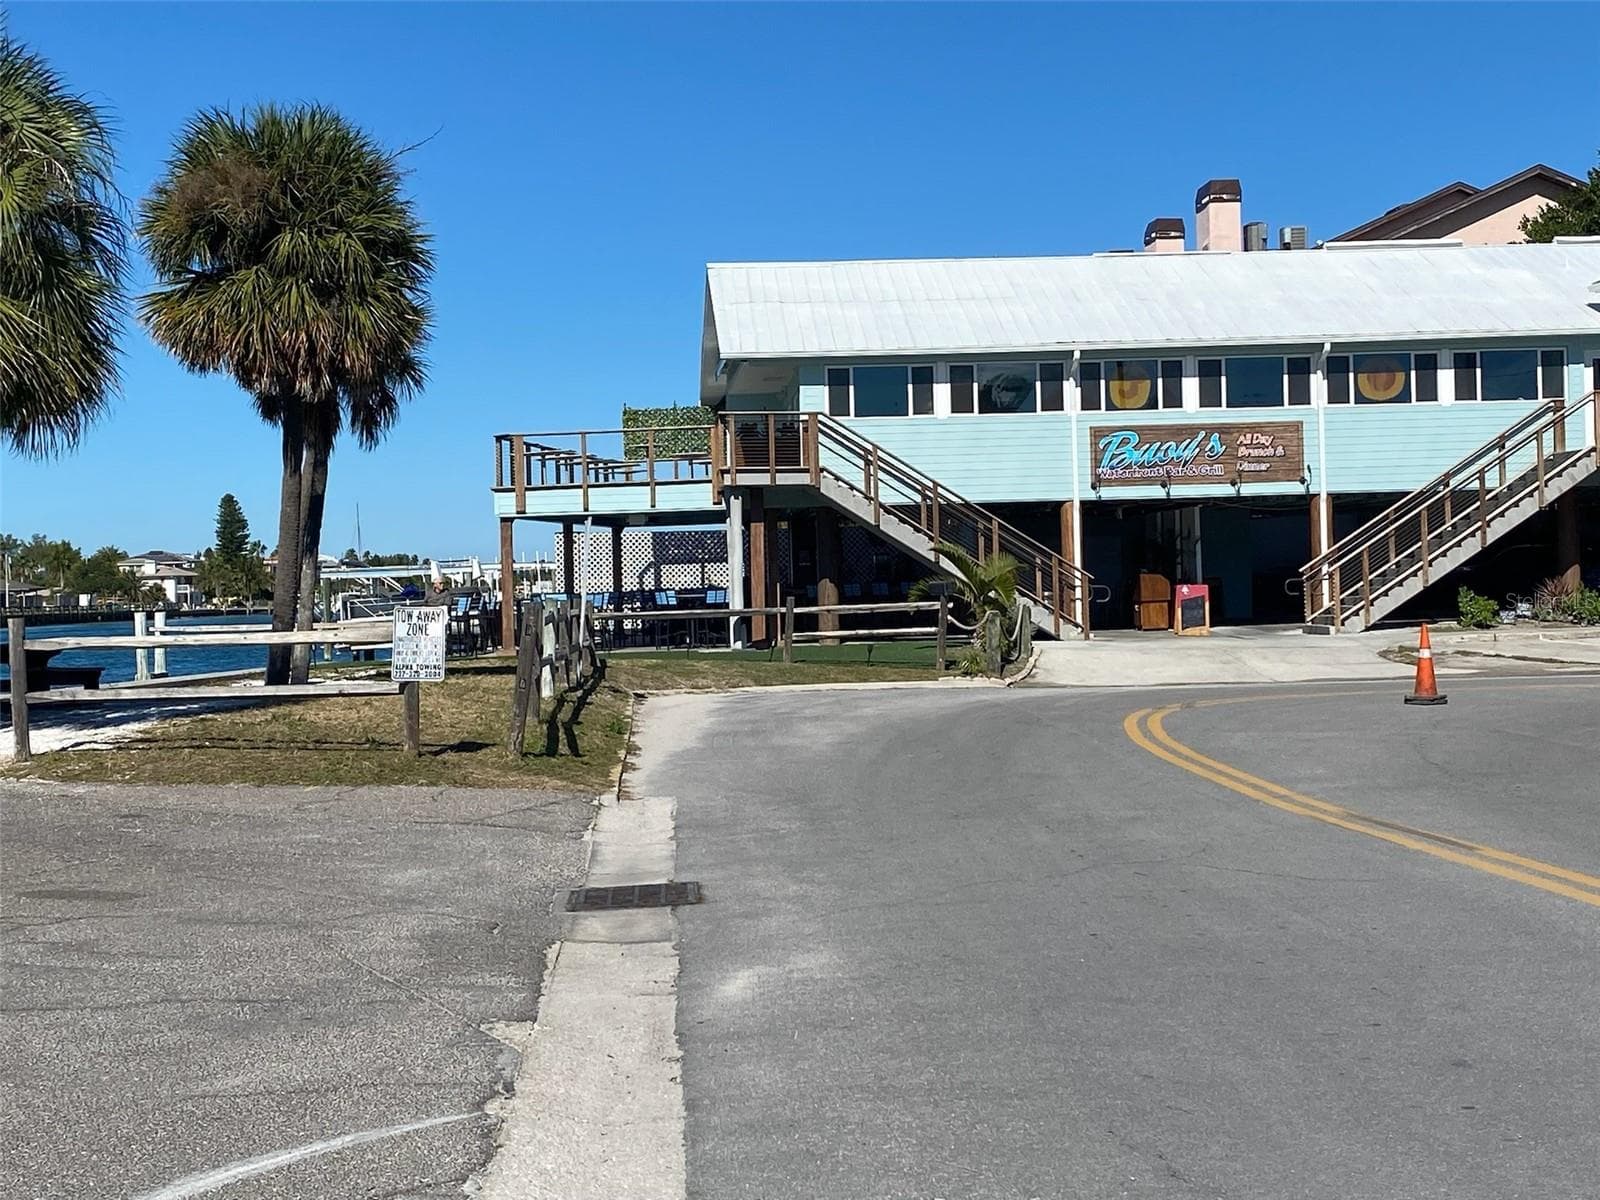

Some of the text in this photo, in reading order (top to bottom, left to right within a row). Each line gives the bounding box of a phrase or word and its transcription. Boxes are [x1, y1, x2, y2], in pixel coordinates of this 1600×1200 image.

[1236, 433, 1274, 446] All Day
[1098, 430, 1226, 470] Buoy's
[1237, 444, 1285, 457] Brunch &
[1096, 463, 1225, 481] Waterfront Bar & Grill
[1236, 460, 1271, 472] Dinner
[397, 609, 441, 623] TOW AWAY
[406, 622, 429, 636] ZONE
